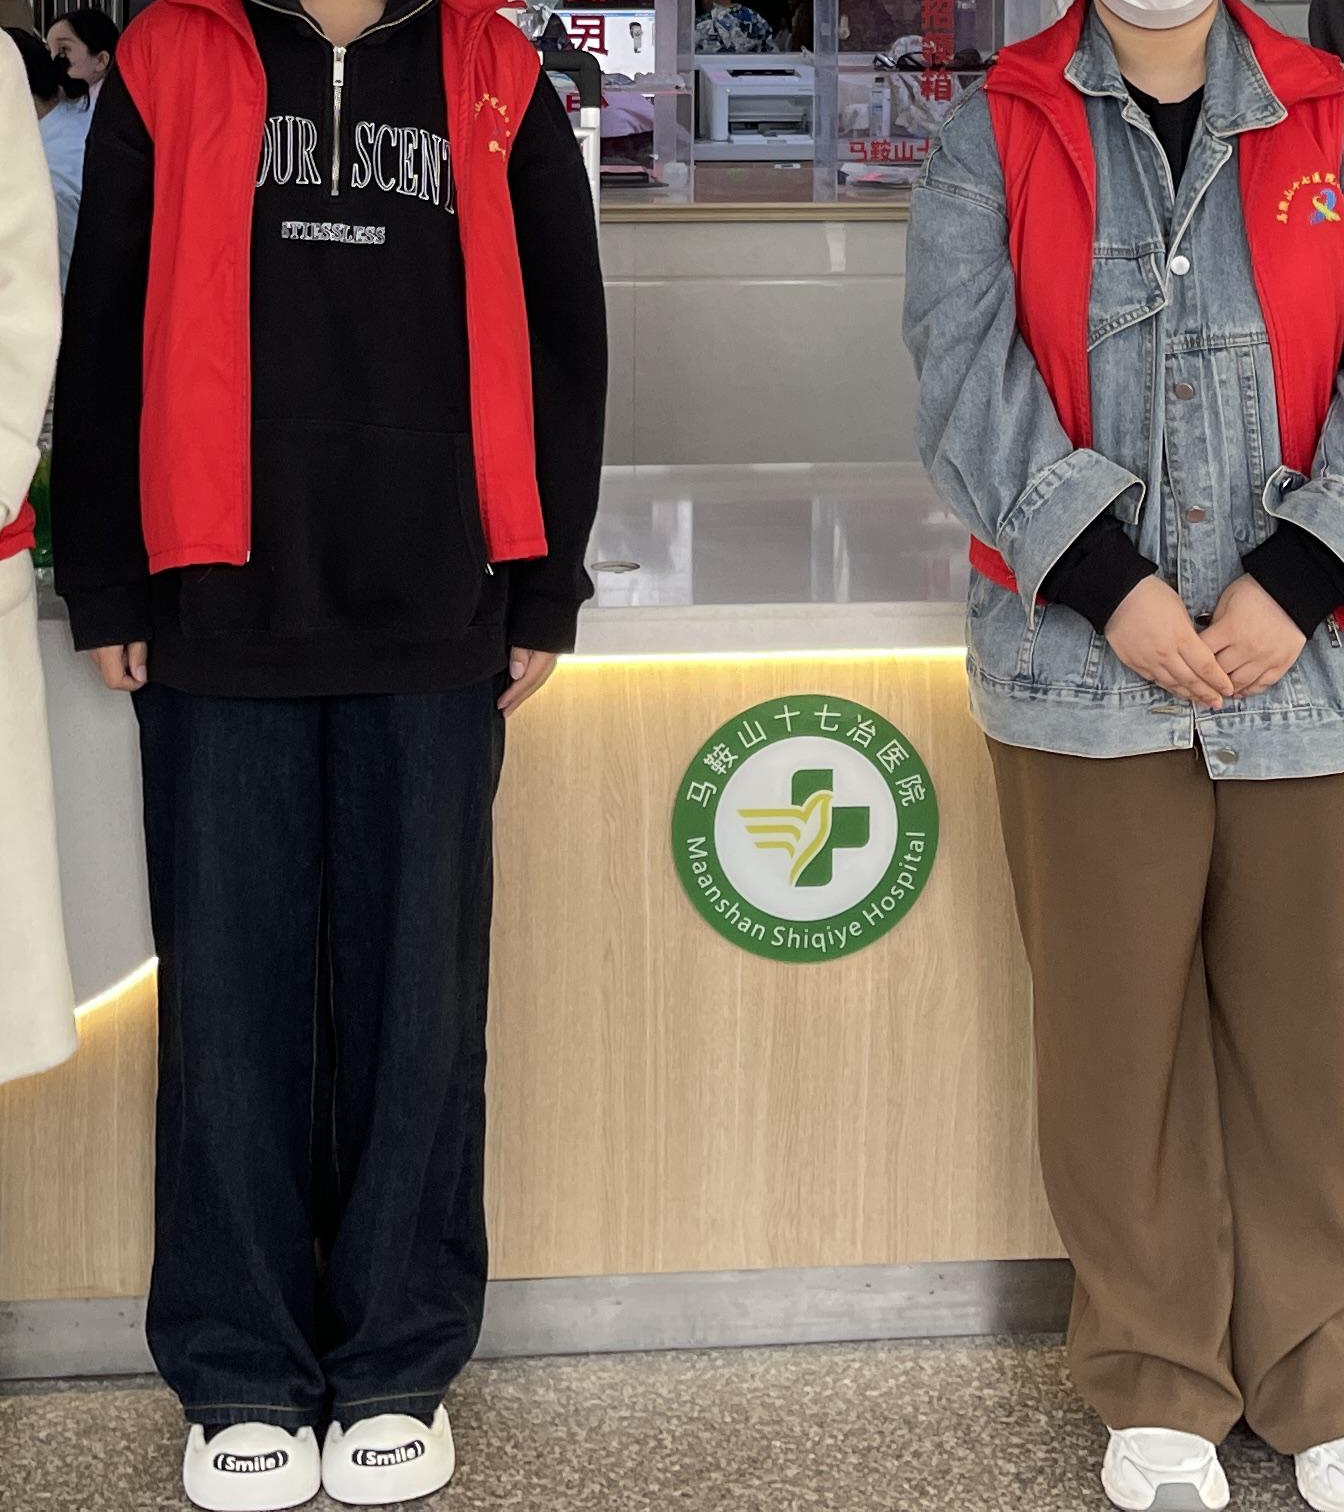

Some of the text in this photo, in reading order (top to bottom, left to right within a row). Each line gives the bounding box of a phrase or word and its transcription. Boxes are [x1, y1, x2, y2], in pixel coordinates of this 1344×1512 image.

[686, 703, 926, 807] 马鞍山十七冶医院
[686, 831, 927, 953] Maanshan Shiqiye Hospital
